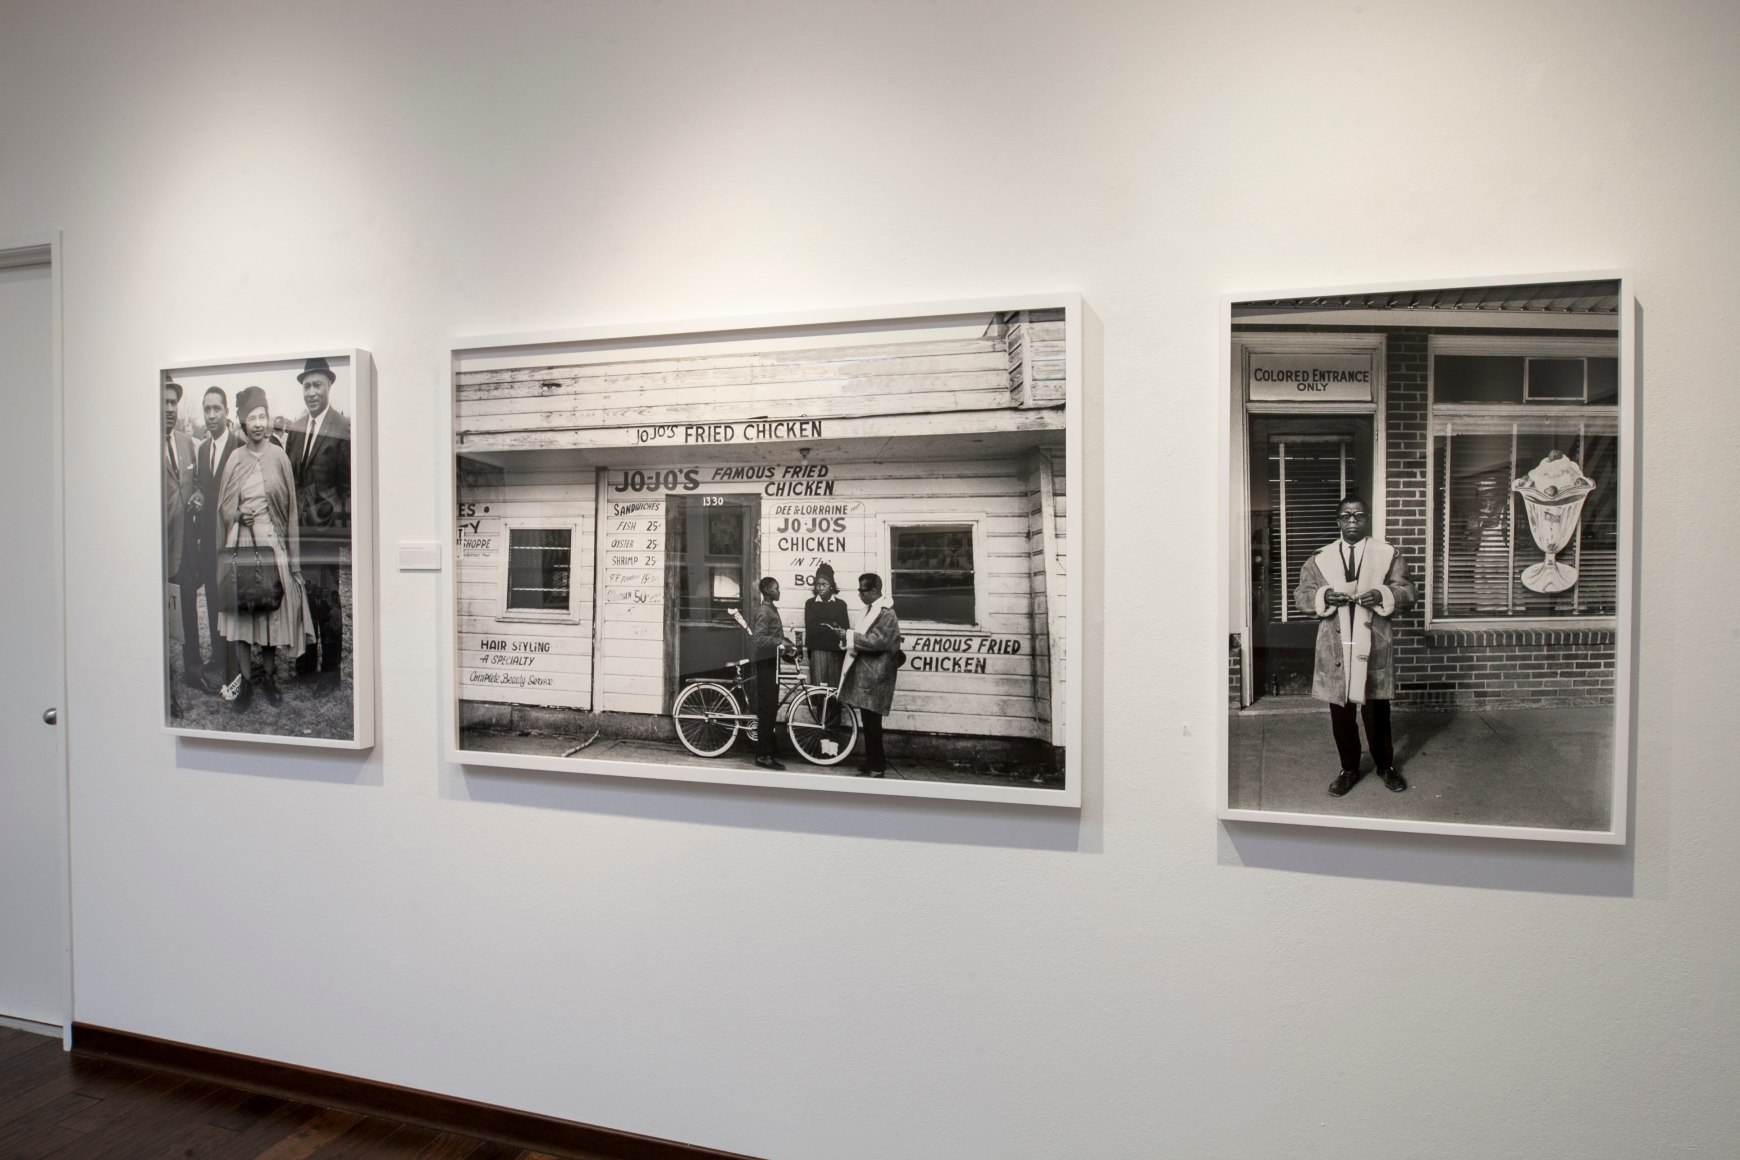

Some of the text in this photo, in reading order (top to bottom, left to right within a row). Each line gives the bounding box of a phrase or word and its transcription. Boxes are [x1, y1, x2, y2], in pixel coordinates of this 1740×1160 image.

[1254, 368, 1369, 383] COLORED ENTRANCE
[1296, 382, 1329, 391] ONLY
[684, 425, 735, 443] FRIED
[743, 421, 822, 441] CHICKEN
[711, 466, 776, 480] FAMOUS
[782, 465, 829, 479] FRIED
[764, 481, 835, 497] CHICKEN
[703, 496, 724, 506] 1330
[613, 502, 660, 516] SANDWICHES
[775, 505, 792, 515] DEE
[800, 504, 848, 515] LORRAINE
[616, 521, 637, 531] FISH
[611, 539, 634, 548] OYSTER
[778, 536, 846, 552] CHICKEN
[611, 555, 656, 566] SHRIMP 25
[790, 557, 805, 567] IN
[794, 574, 816, 586] BO
[480, 639, 507, 651] HAIR
[912, 637, 1022, 655] FAMOUS FRIED
[480, 654, 536, 666] A SPECIALTY
[910, 656, 987, 674] CHICKEN
[469, 670, 501, 683] Complete
